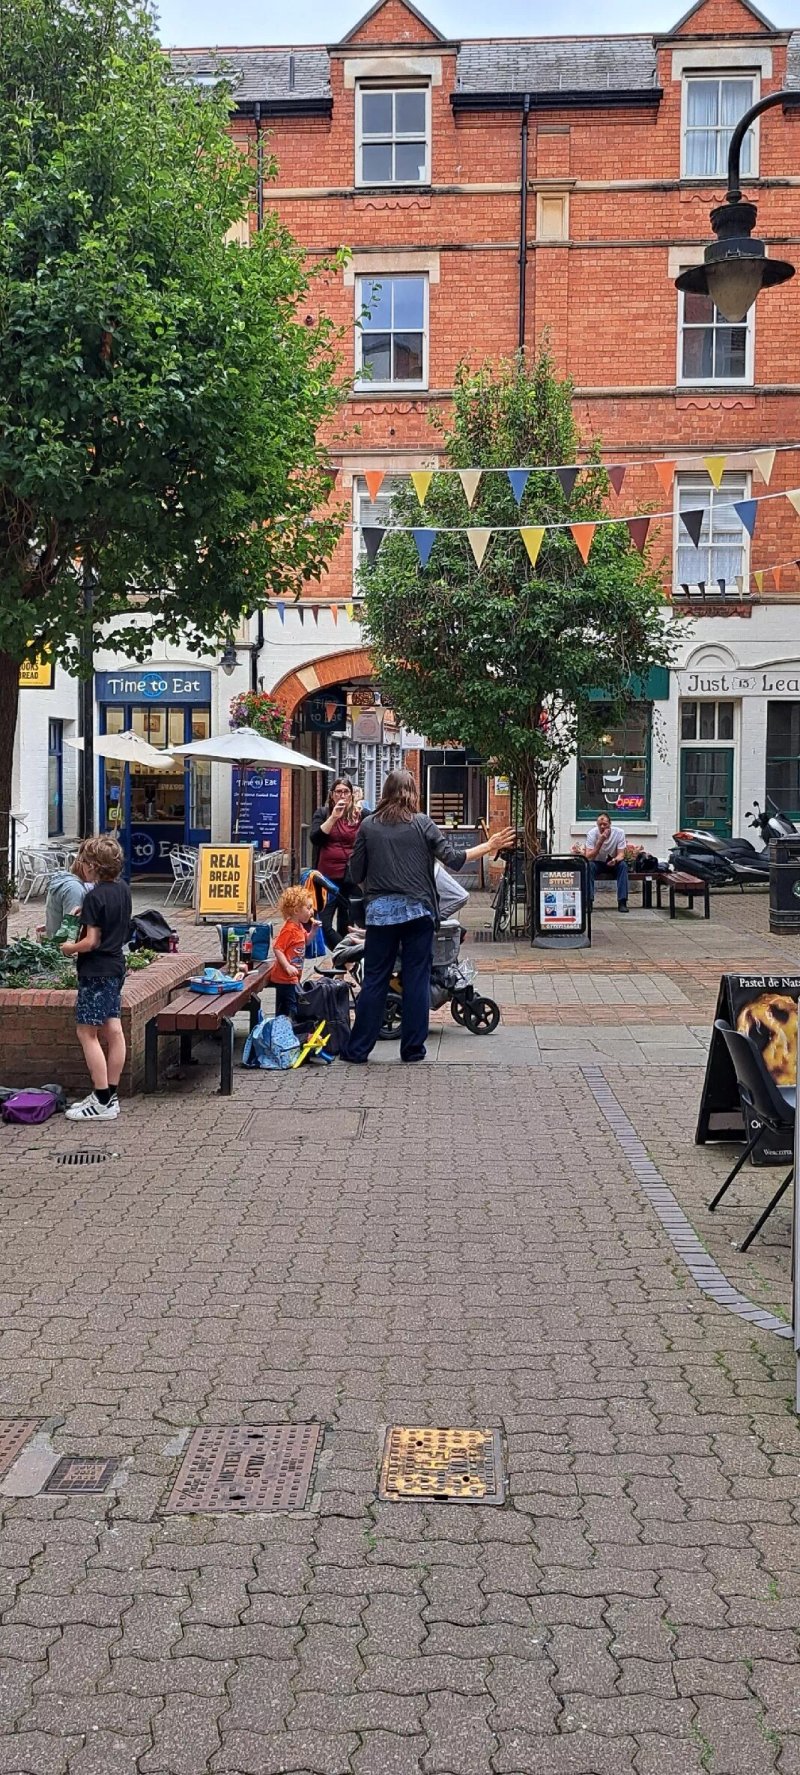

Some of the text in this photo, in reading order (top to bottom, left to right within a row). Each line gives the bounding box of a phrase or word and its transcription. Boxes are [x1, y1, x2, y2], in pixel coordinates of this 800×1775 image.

[107, 678, 200, 695] Time to Eat
[687, 674, 730, 692] Just
[739, 680, 750, 688] 15
[264, 778, 277, 786] Eat
[616, 798, 643, 808] OPEN
[134, 844, 153, 856] to
[210, 854, 241, 869] REAL
[209, 870, 241, 881] BREAD
[208, 883, 240, 898] HERE
[739, 976, 766, 988] Pastel
[768, 977, 780, 988] de
